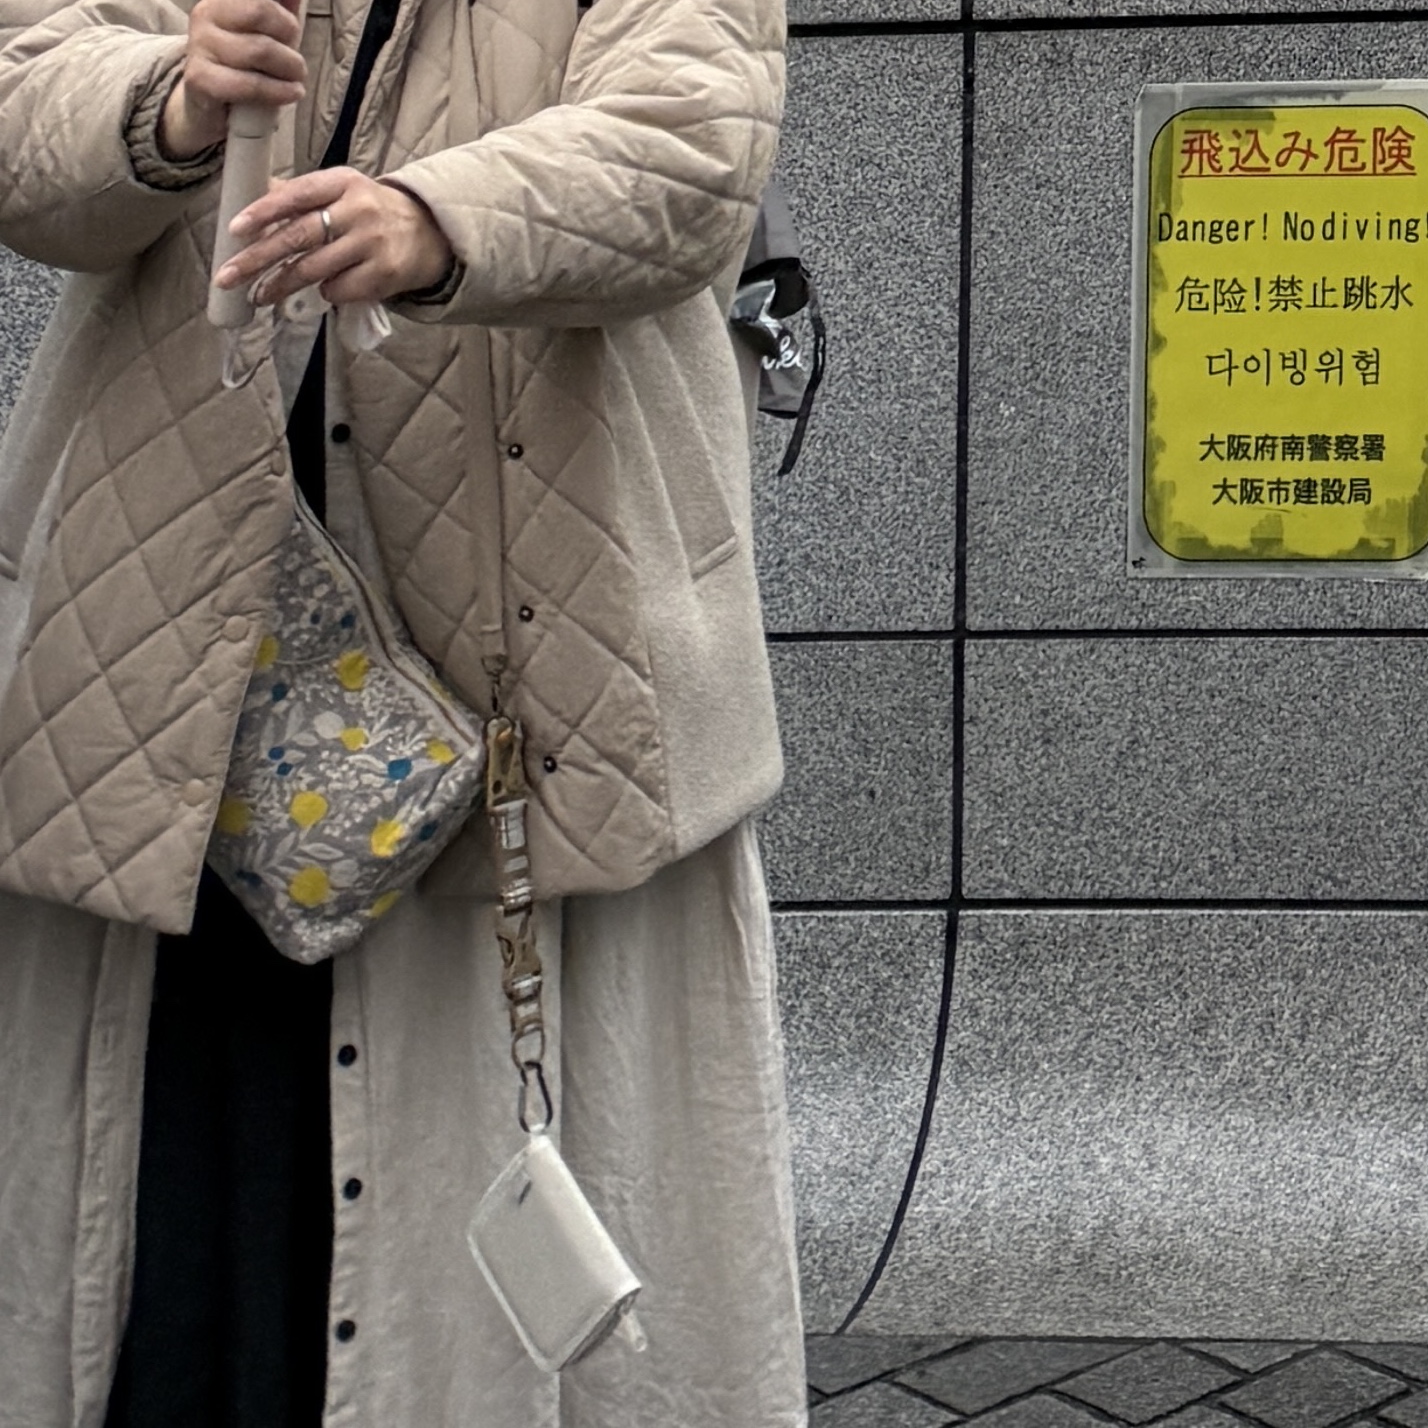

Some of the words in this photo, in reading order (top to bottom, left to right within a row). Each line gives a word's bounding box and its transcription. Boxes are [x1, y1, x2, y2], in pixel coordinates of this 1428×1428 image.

[1180, 125, 1416, 173] 飛込み危険
[1158, 212, 1269, 244] Danger!
[1205, 346, 1382, 387] 다이빙위험
[1199, 433, 1386, 463] 大阪府南警察署
[1211, 477, 1373, 506] 大阪市建設局
